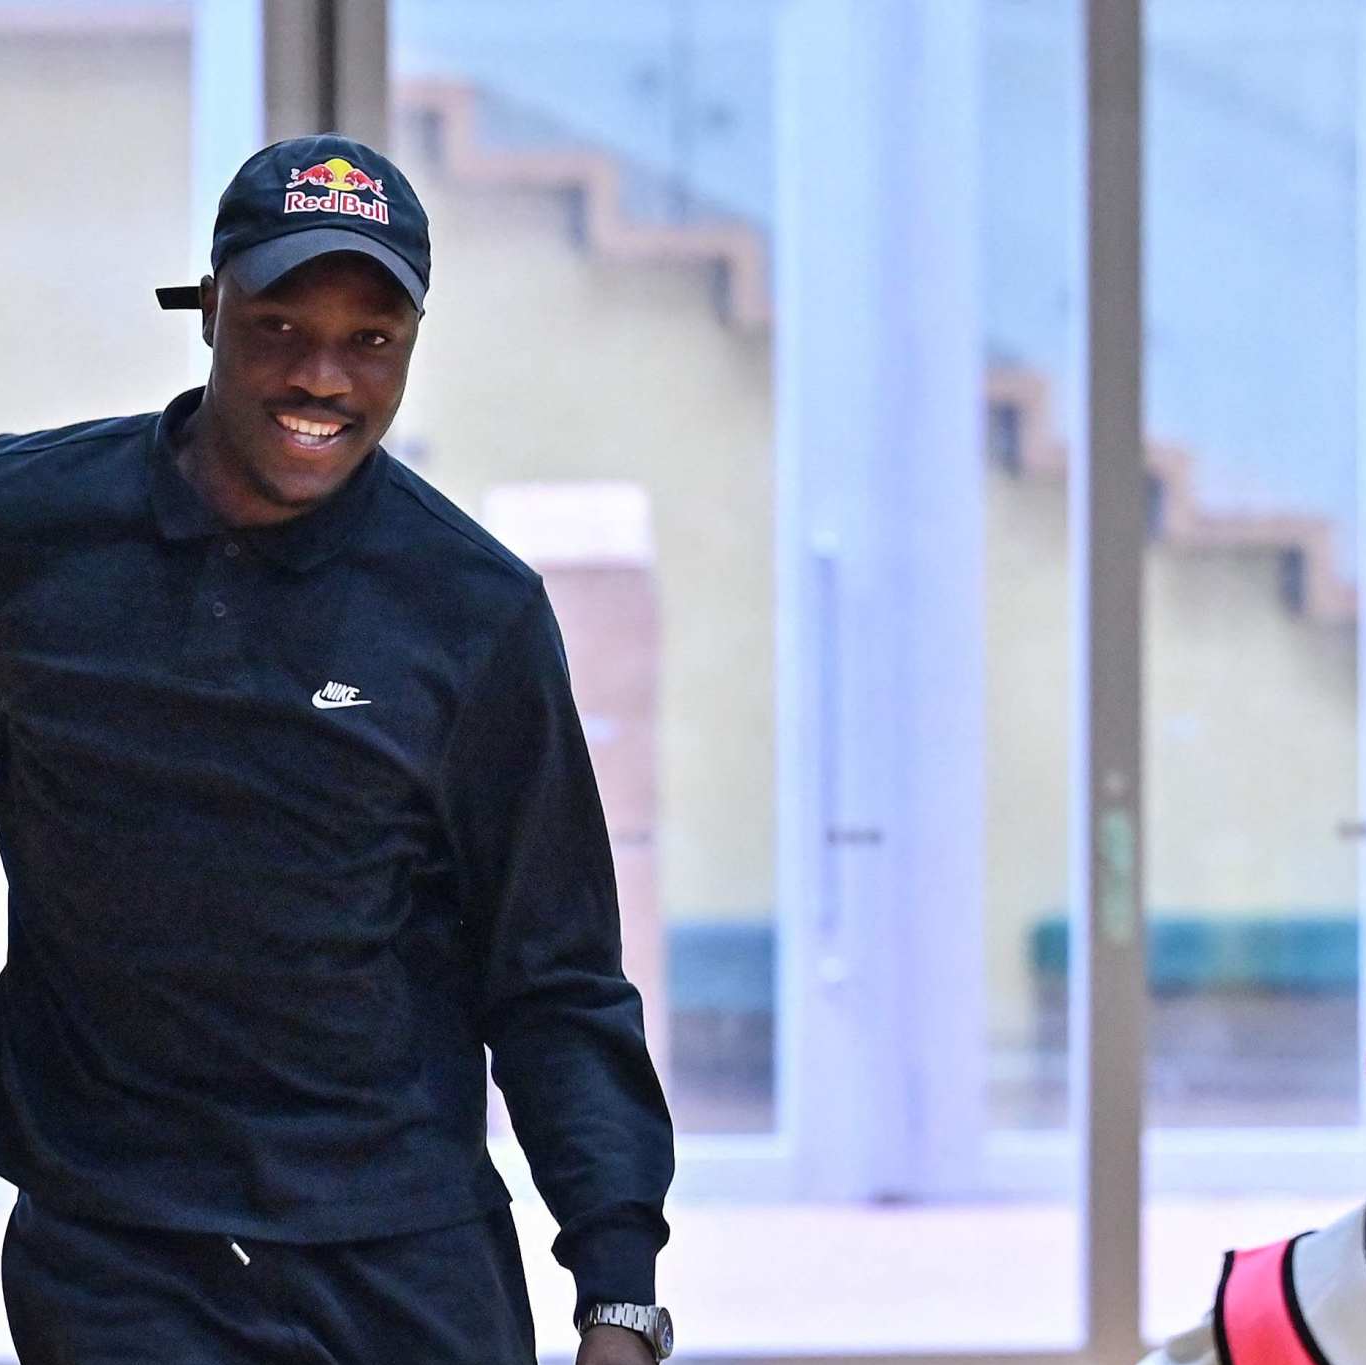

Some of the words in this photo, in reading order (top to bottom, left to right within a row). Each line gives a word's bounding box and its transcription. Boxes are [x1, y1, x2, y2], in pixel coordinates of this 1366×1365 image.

[284, 189, 339, 213] Red
[340, 191, 389, 224] Bull
[321, 680, 361, 702] NIKE
